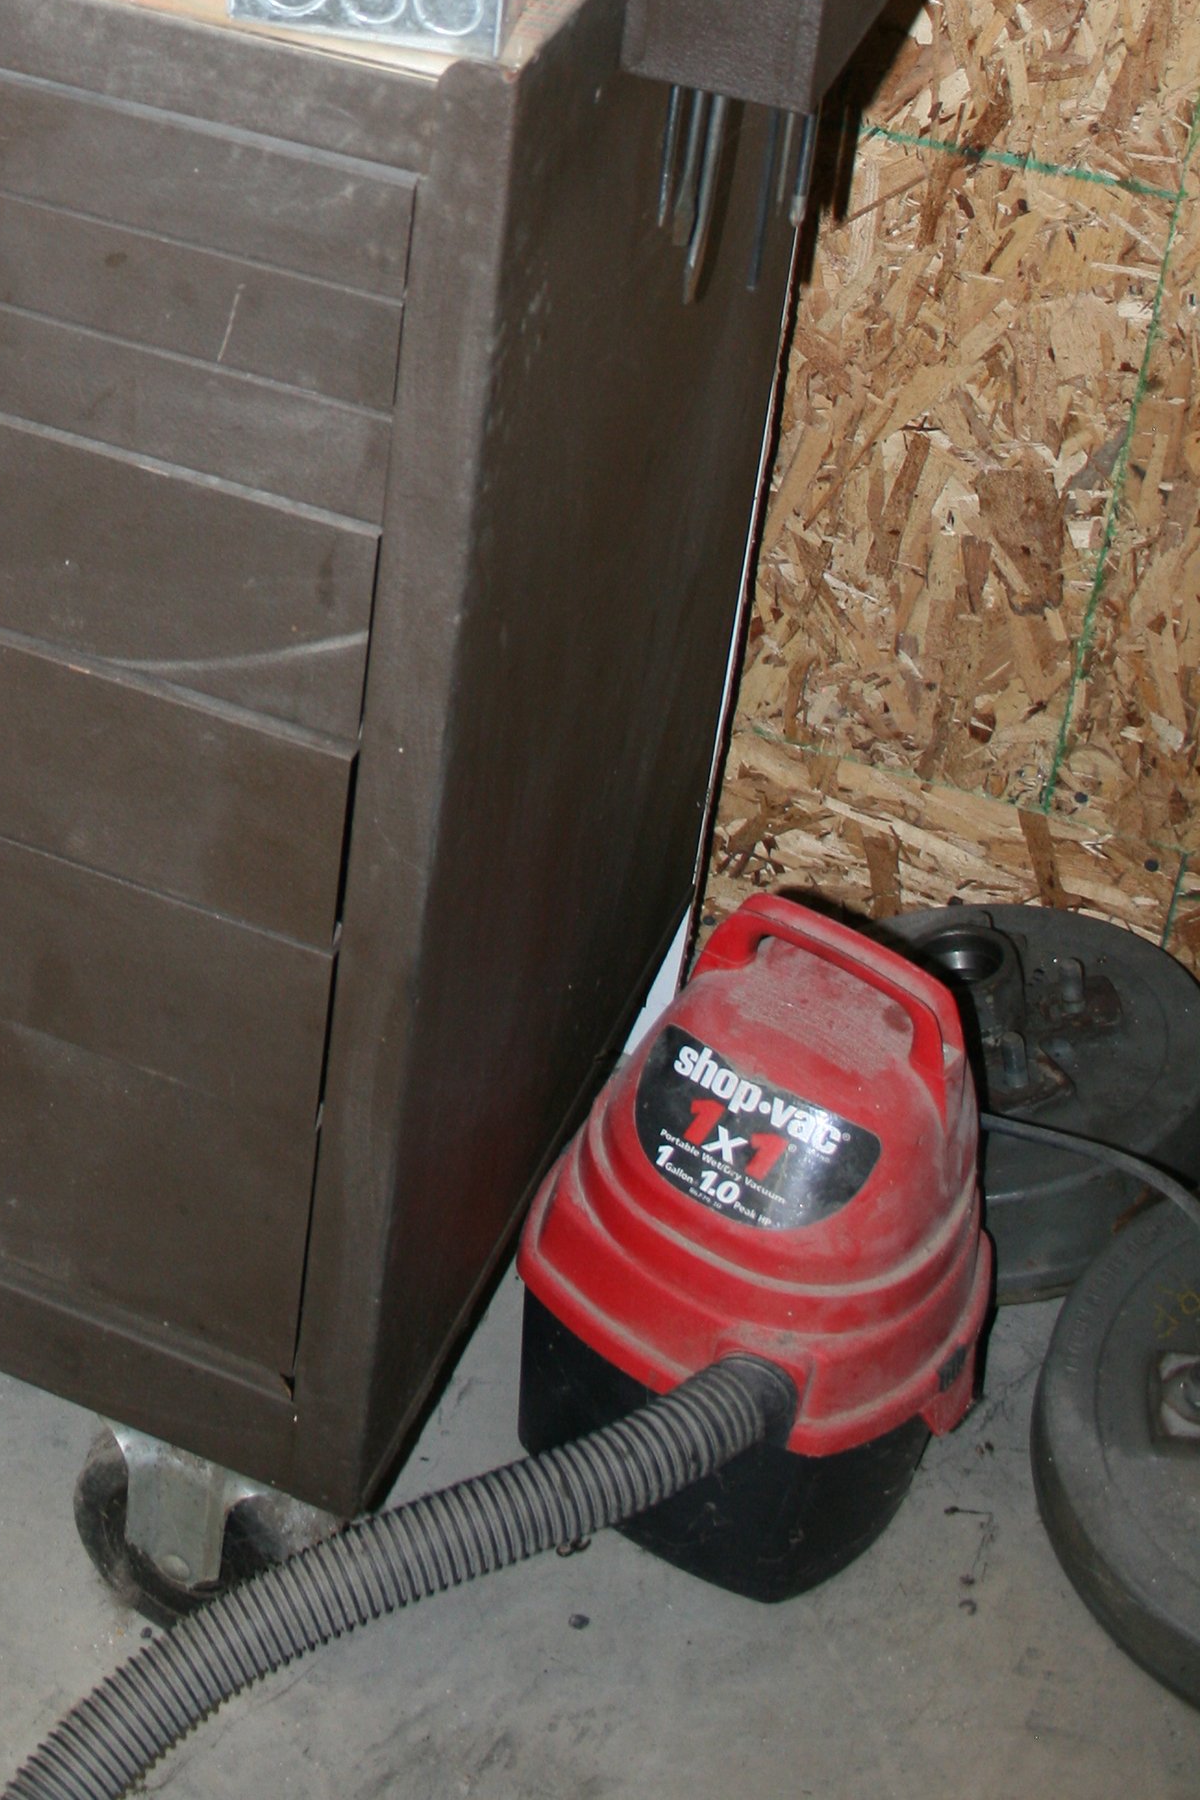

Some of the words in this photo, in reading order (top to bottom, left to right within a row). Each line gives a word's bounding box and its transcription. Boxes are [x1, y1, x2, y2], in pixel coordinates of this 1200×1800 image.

[656, 1144, 674, 1168] 1
[659, 1128, 700, 1157] Portable
[702, 1153, 742, 1182] Wet/Dry
[744, 1176, 787, 1205] Vacuum
[664, 1162, 694, 1184] Gallon
[699, 1170, 741, 1204] 1.0
[733, 1200, 755, 1219] Peak
[758, 1214, 772, 1226] HP
